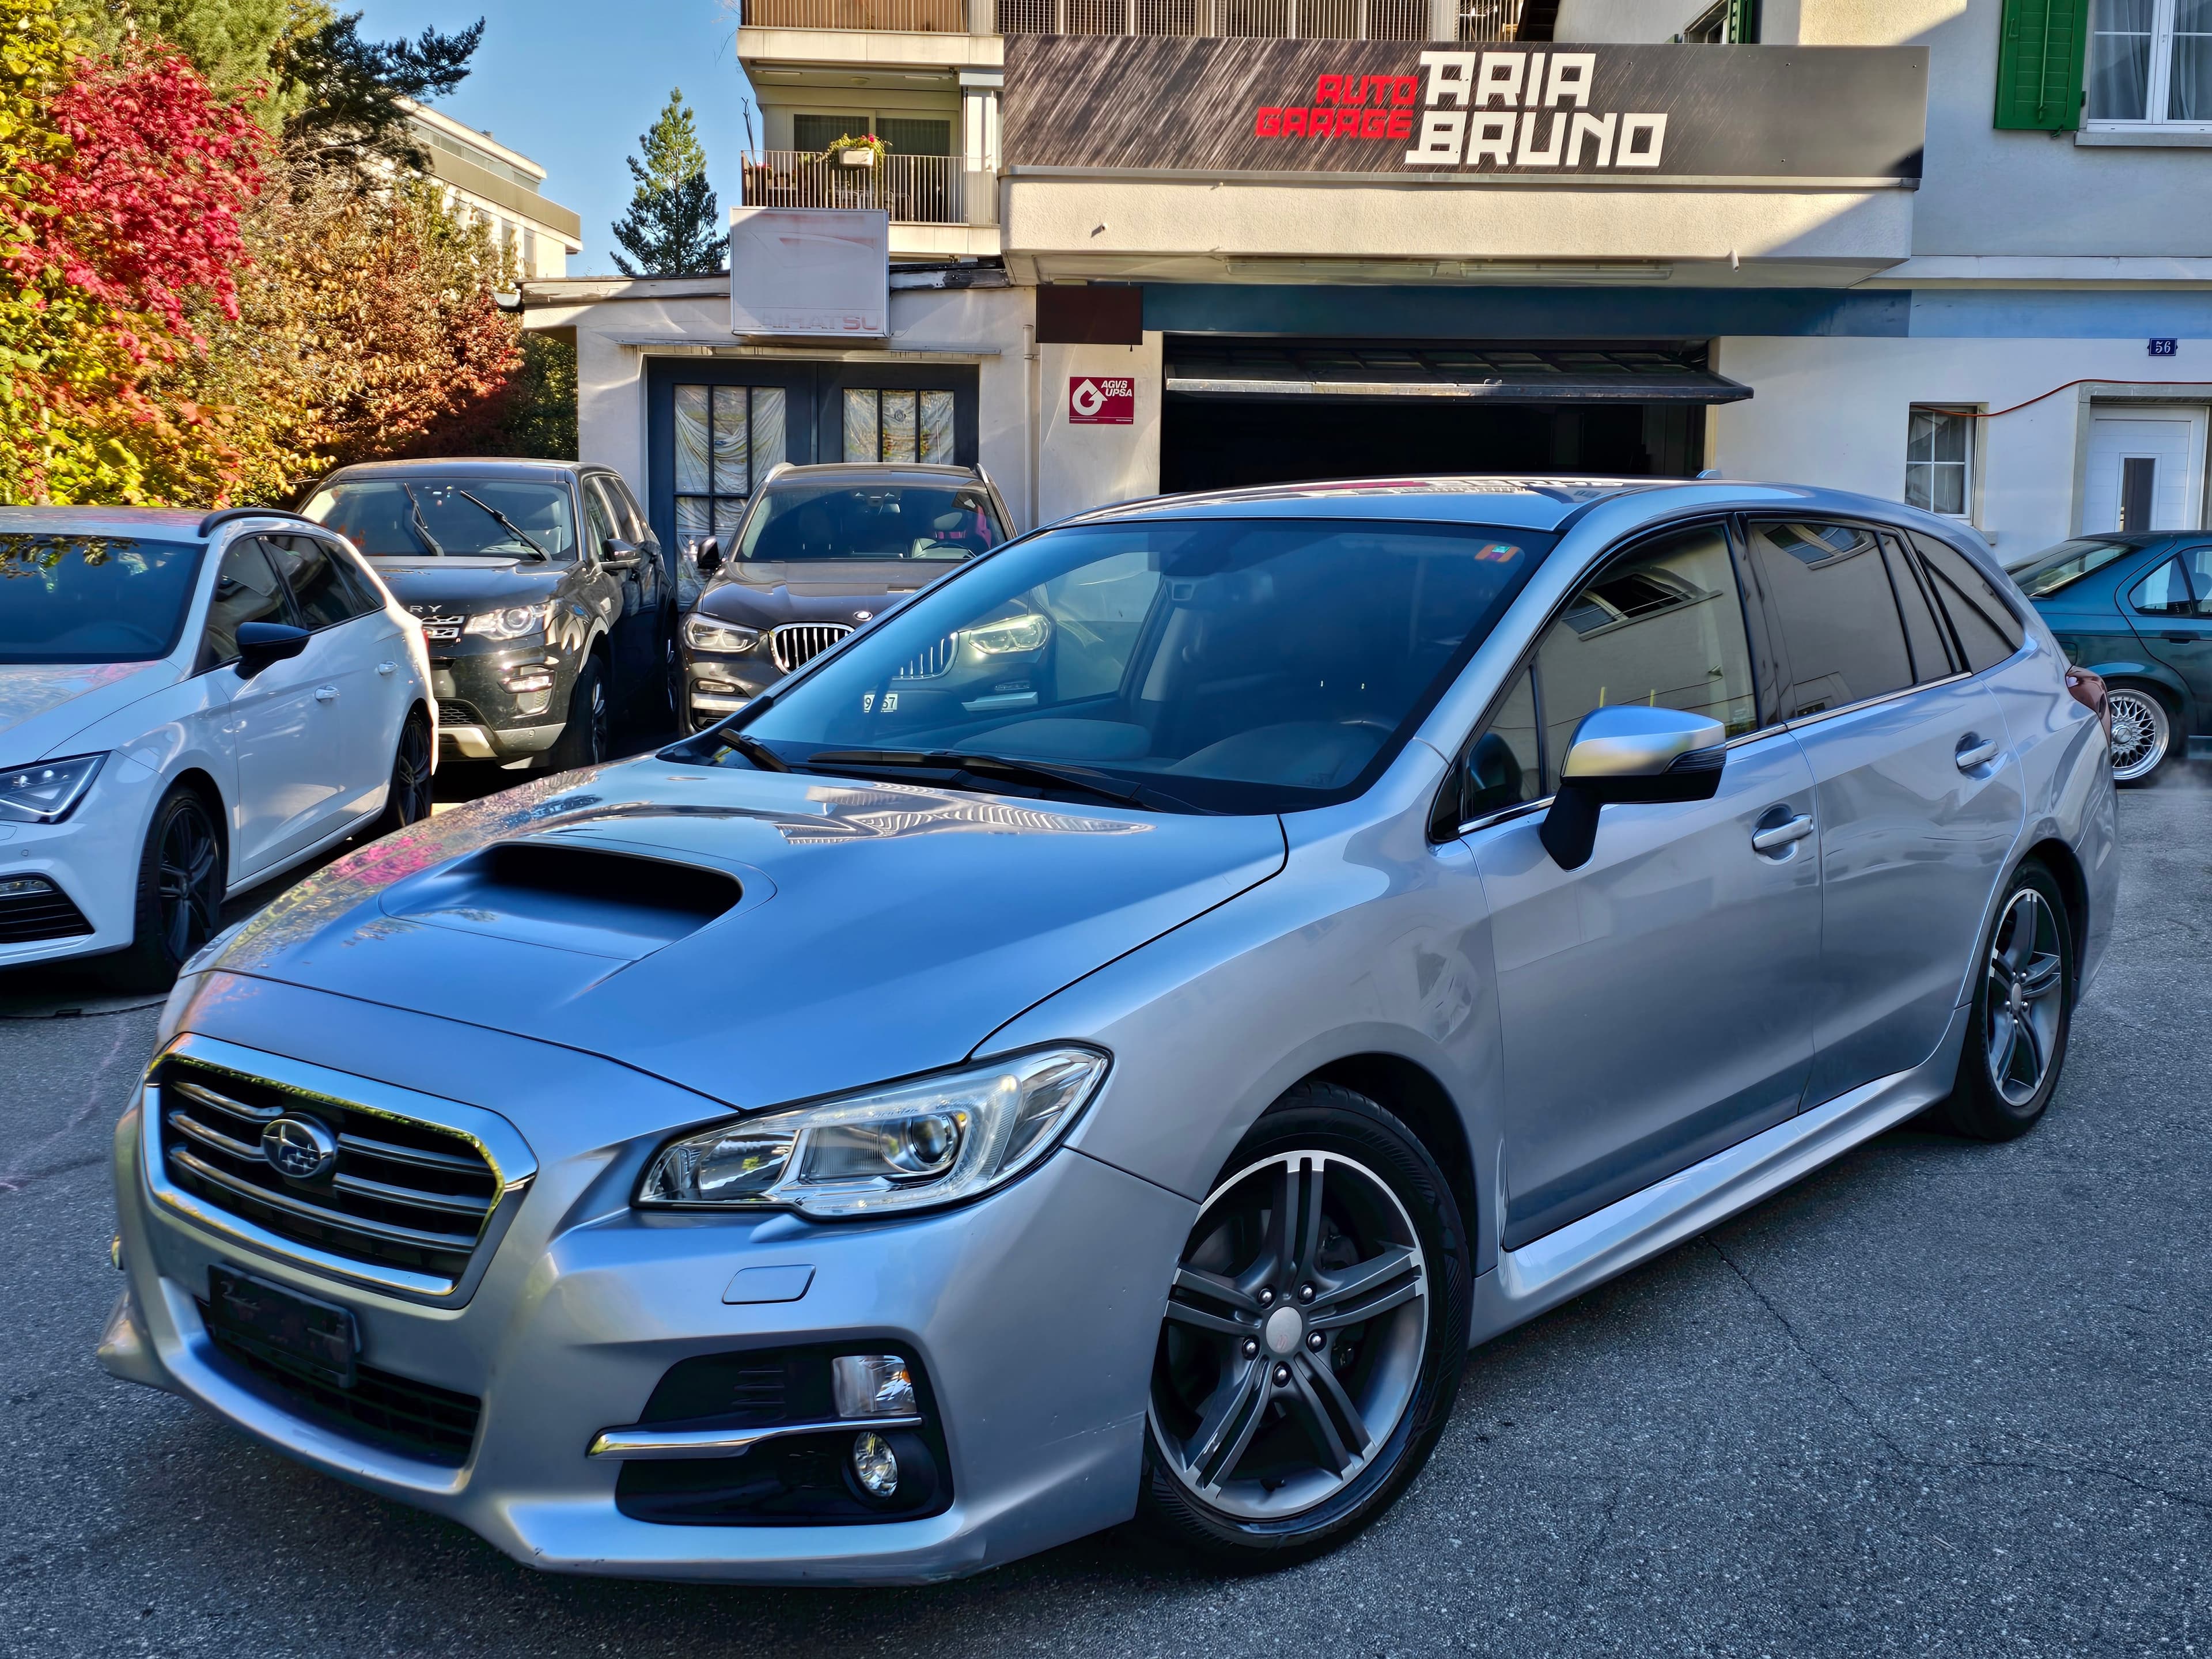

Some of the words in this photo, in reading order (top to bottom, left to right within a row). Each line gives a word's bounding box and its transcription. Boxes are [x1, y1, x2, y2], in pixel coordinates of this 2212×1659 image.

[1316, 74, 1418, 105] AUTO
[1419, 51, 1596, 107] ARIA
[1256, 107, 1413, 138] GARAGE
[1404, 110, 1668, 167] BRUNO
[2156, 340, 2171, 353] 56
[1105, 388, 1132, 397] UPSA
